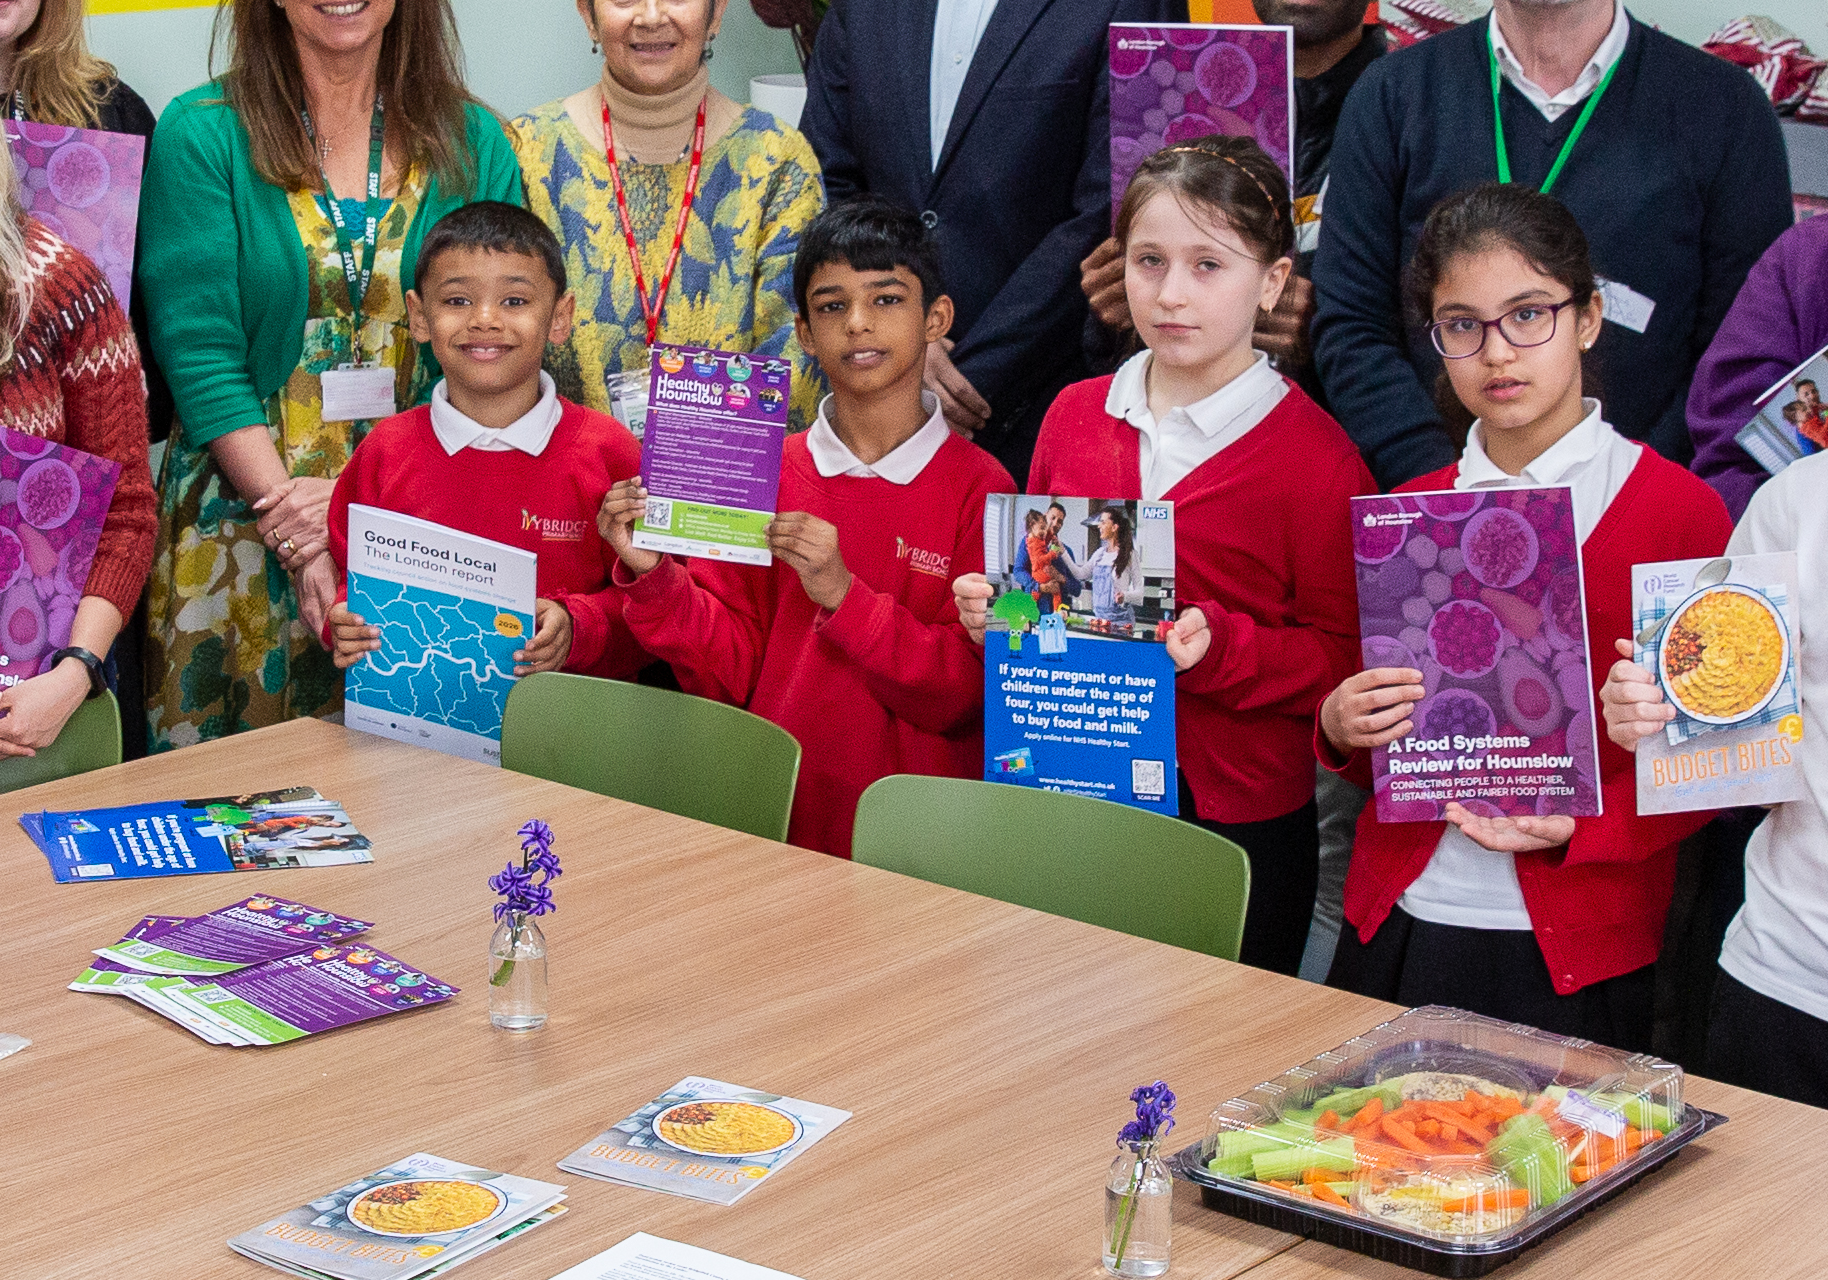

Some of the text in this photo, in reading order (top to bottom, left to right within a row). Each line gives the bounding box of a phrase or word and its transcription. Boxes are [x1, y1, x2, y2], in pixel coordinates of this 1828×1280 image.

[368, 171, 379, 198] STAFF
[365, 216, 377, 246] STAFF
[342, 250, 357, 283] STAFF
[655, 389, 723, 406] Hounslow
[658, 373, 711, 398] Healthy
[1144, 507, 1168, 519] NHS
[364, 530, 497, 573] Good Food Local
[364, 544, 495, 587] The London report
[498, 620, 520, 631] 2026
[999, 663, 1009, 675] If
[1051, 670, 1106, 684] pregnant
[1109, 676, 1122, 685] or
[1125, 674, 1157, 687] have
[1001, 680, 1154, 704] children under the age of
[1005, 696, 1150, 722] four, you could get help
[1012, 713, 1142, 735] to buy food and milk.
[1387, 734, 1531, 754] A Food Systems
[1389, 753, 1573, 775] Review for Hounslow
[1652, 746, 1730, 788] BUDGET
[1737, 736, 1792, 772] BITES
[1390, 774, 1566, 791] CONNECTING PEOPLE TO A HEALTHIER,
[1391, 786, 1575, 802] SUSTAINABLE AND FAIRER FOOD SYSTEM
[589, 1143, 746, 1186] BUDGET BITES
[264, 1221, 412, 1265] BUDGET BITES
